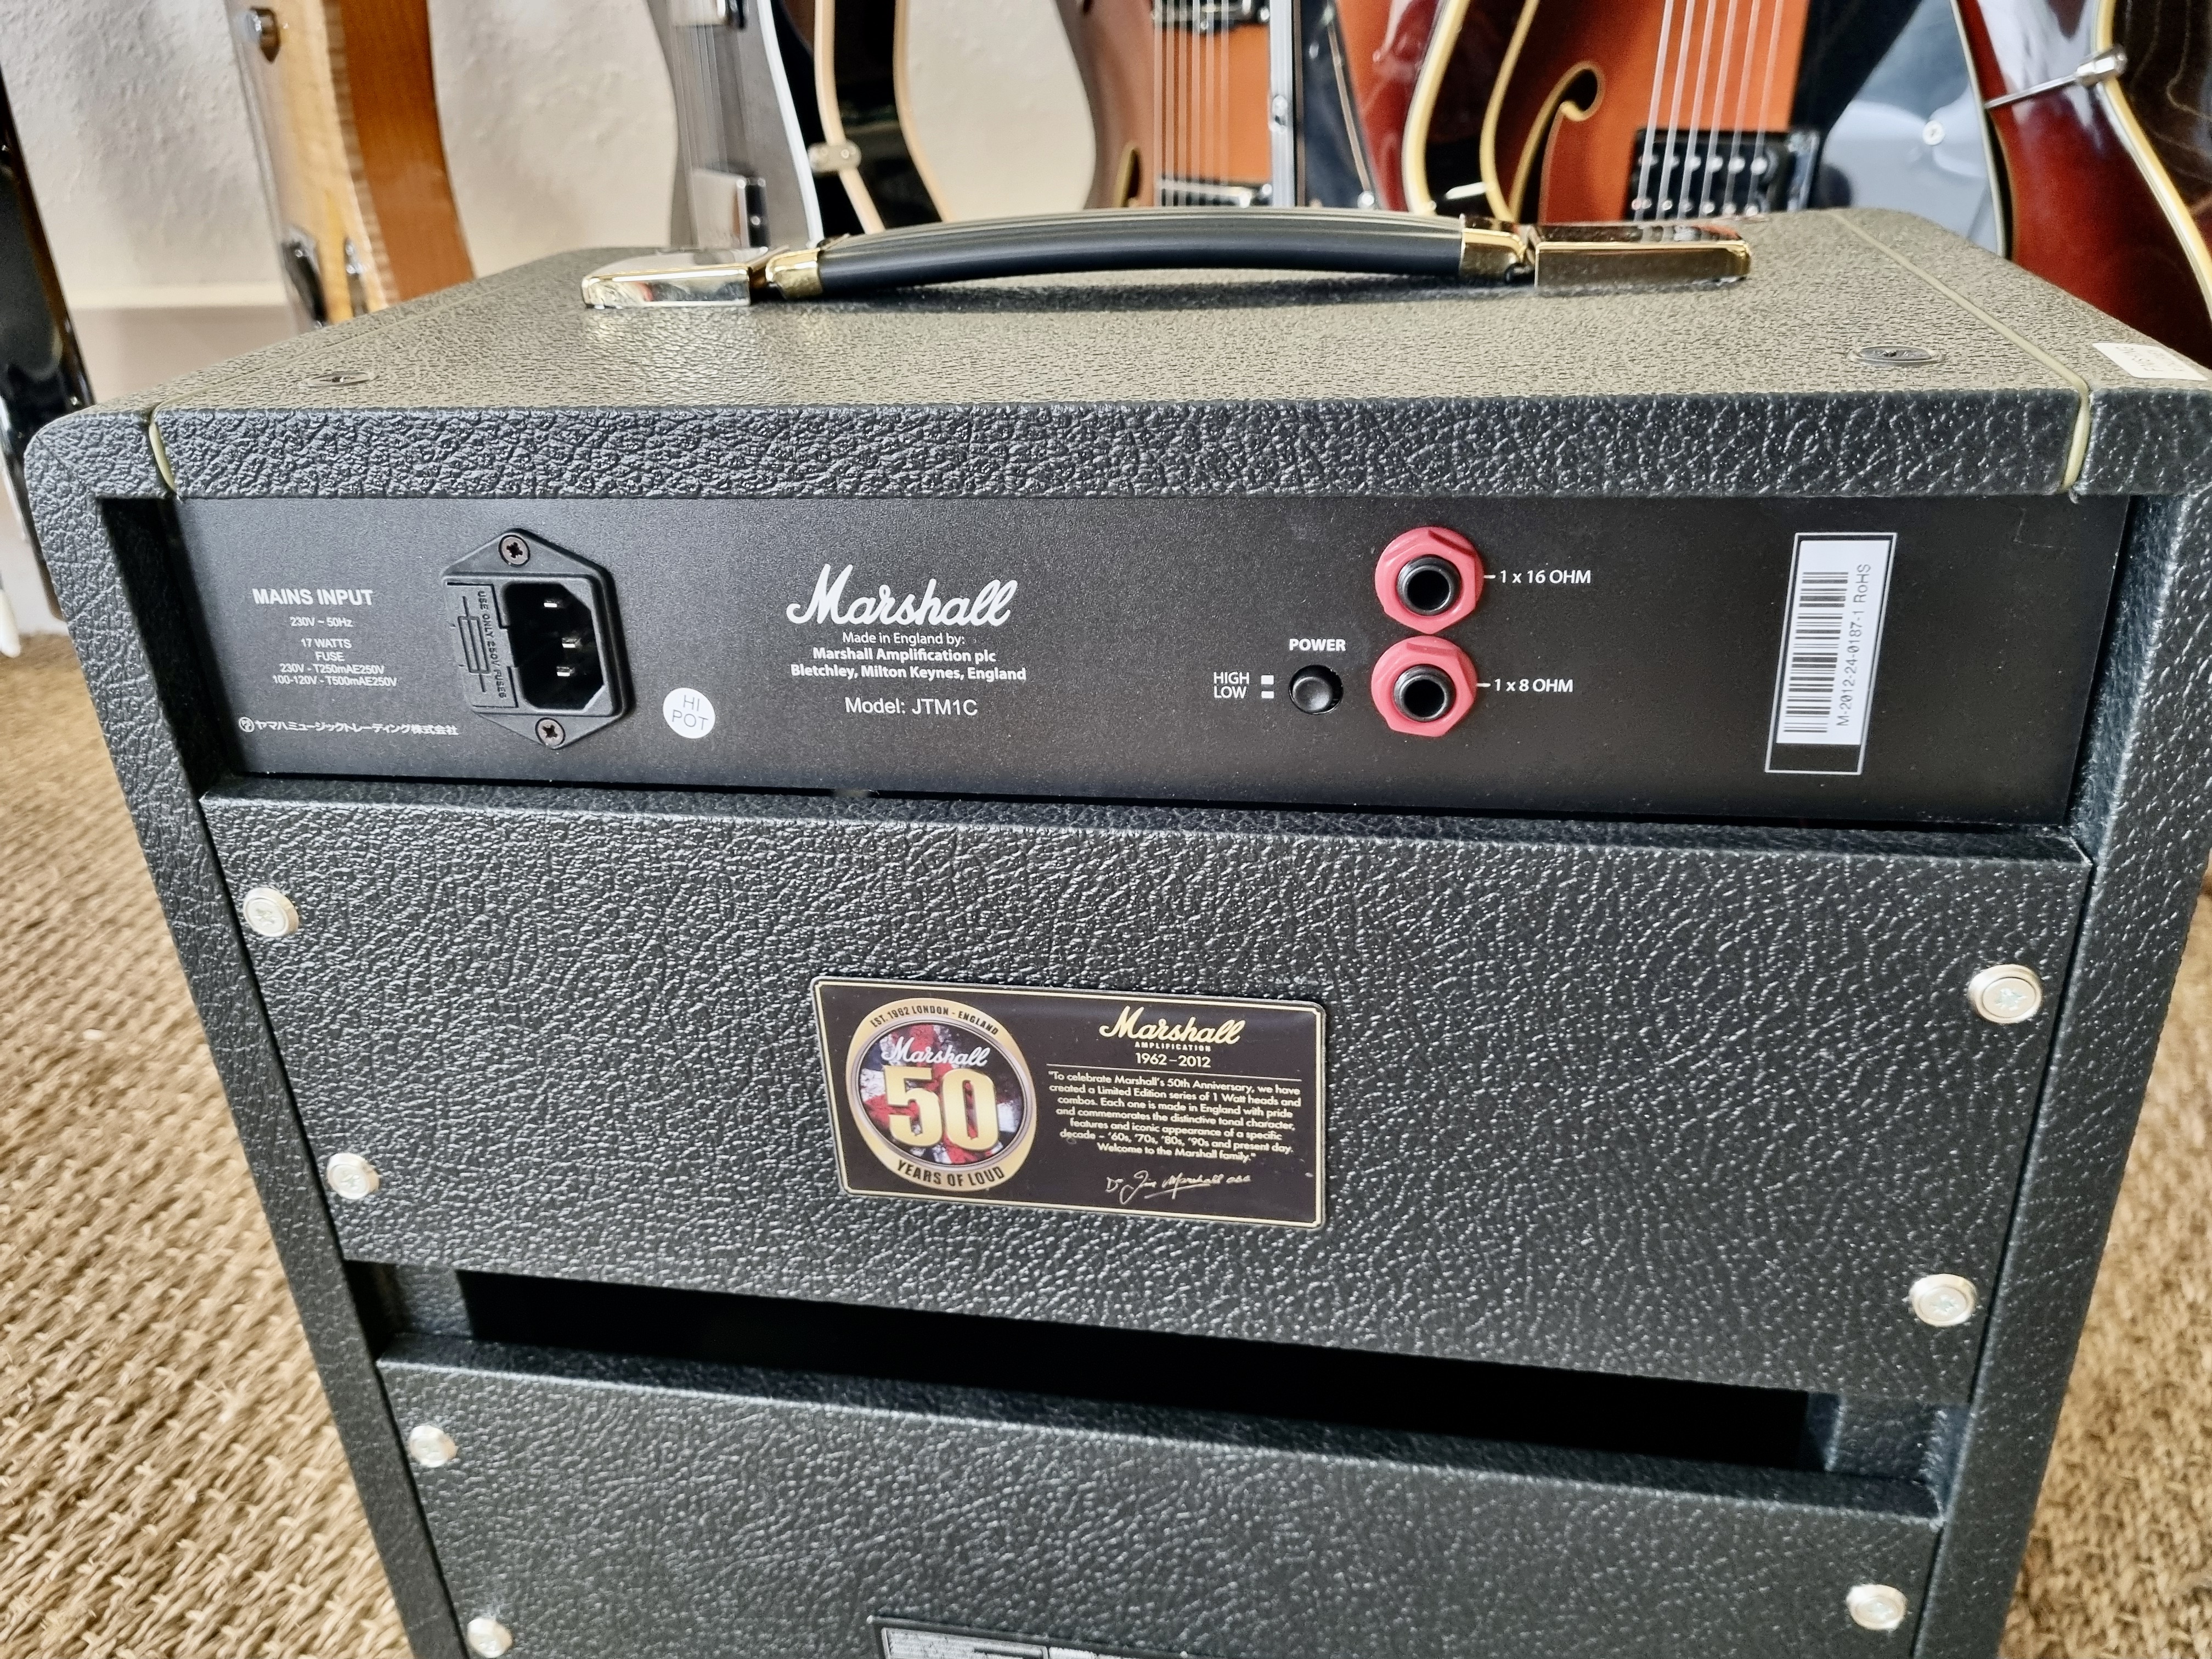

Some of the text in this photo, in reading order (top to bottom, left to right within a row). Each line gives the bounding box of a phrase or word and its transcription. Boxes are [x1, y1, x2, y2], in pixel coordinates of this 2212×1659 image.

[1500, 570, 1592, 584] 1 x 16 OHM
[252, 589, 373, 606] MAINS INPUT
[786, 563, 1018, 627] Marshall
[290, 616, 315, 627] 230V
[326, 617, 354, 627] 50Hz
[482, 613, 494, 639] ONLY
[301, 638, 352, 648] 17 WATTS
[842, 631, 966, 647] Made in England by:
[1289, 639, 1346, 652] POWER
[1836, 563, 1871, 726] M-2012-24-0187-1 RoHS
[315, 651, 345, 662] FUSE
[812, 647, 996, 665] Marshall Amplification plc
[279, 663, 304, 673] 230V
[312, 663, 385, 674] T250mAE250V
[791, 664, 1026, 682] Bletchley, Milton Keynes, England
[273, 675, 317, 685] 100-120V
[324, 675, 397, 686] T500mAE250V
[1214, 672, 1250, 685] HIGH
[1494, 679, 1573, 693] 1 x 8 OHM
[1214, 685, 1247, 699] LOW
[682, 695, 700, 712] HI
[844, 697, 978, 716] Model: JTM1C
[672, 710, 708, 730] POT
[870, 1015, 888, 1028] EST.
[888, 1007, 910, 1019] 1962
[912, 1005, 949, 1015] LONDON
[958, 1011, 999, 1036] ENGLAND
[1098, 1005, 1246, 1045] Marshall
[880, 1036, 991, 1066] Marshall
[1135, 1041, 1211, 1052] AMPLIFICATION
[1066, 1071, 1112, 1084] celebrate
[1114, 1074, 1165, 1087] Marshall's
[1167, 1078, 1190, 1088] 50th
[1192, 1080, 1255, 1094] Anniversary,
[1257, 1085, 1273, 1093] we
[1275, 1084, 1301, 1096] have
[1048, 1084, 1086, 1093] created
[1097, 1085, 1131, 1097] Limited
[1133, 1087, 1167, 1098] Edition
[1169, 1091, 1197, 1101] series
[1199, 1091, 1210, 1101] of
[1213, 1092, 1218, 1102] 1
[1221, 1092, 1246, 1103] Watt
[1248, 1094, 1279, 1105] heads
[1280, 1097, 1302, 1107] and
[883, 1064, 999, 1150] 50
[1057, 1094, 1098, 1105] combos.
[1100, 1097, 1125, 1107] Each
[1148, 1100, 1156, 1110] is
[1158, 1102, 1187, 1111] made
[1188, 1103, 1198, 1112] in
[1200, 1103, 1242, 1116] England
[1242, 1106, 1265, 1116] with
[1266, 1108, 1294, 1119] pride
[1055, 1106, 1296, 1131] and commemorates the distinctive tonal character,
[1070, 1117, 1109, 1130] features
[1110, 1121, 1130, 1131] and
[1131, 1122, 1160, 1133] iconic
[1161, 1126, 1222, 1136] appearance
[1223, 1127, 1235, 1138] of
[1245, 1131, 1283, 1141] specific
[1059, 1128, 1096, 1139] decade
[1211, 1139, 1232, 1149] and
[1233, 1141, 1270, 1151] present
[1271, 1142, 1294, 1155] day.
[1097, 1142, 1143, 1154] Welcome
[1144, 1146, 1155, 1155] to
[1156, 1146, 1173, 1156] the
[1174, 1148, 1218, 1159] Marshall
[897, 1159, 1005, 1187] YEARS OF LOUD
